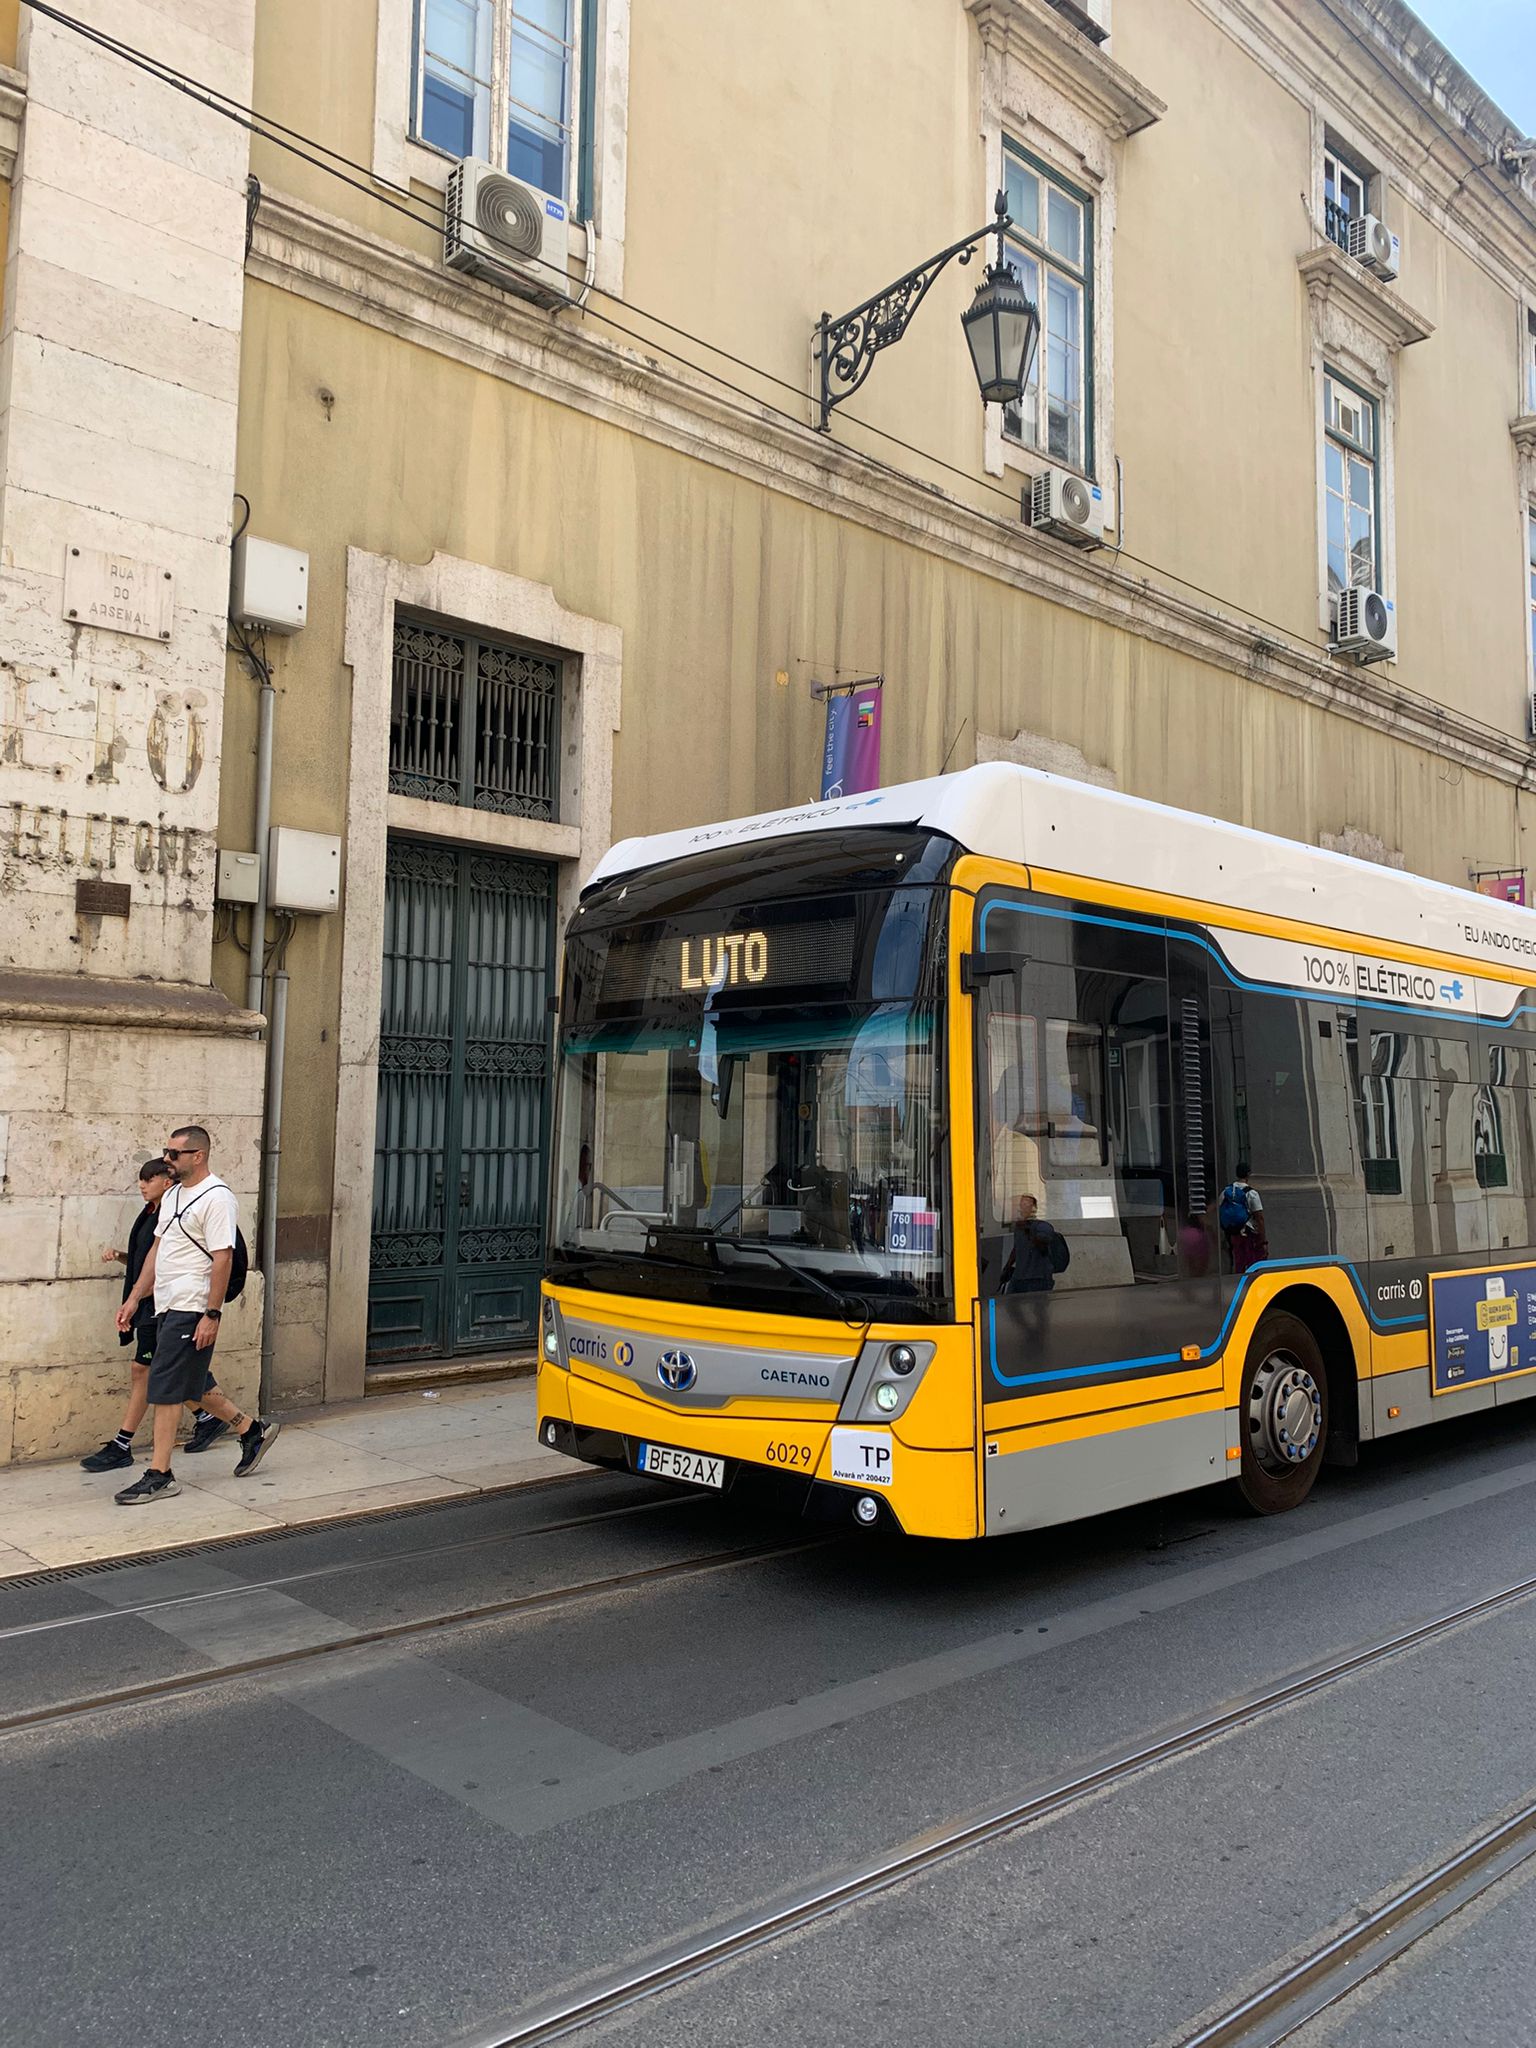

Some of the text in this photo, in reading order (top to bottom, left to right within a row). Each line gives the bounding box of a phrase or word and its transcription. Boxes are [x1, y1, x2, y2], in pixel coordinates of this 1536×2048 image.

[110, 564, 134, 581] RUA
[113, 586, 130, 600] DO
[89, 601, 150, 627] ARSENAL
[827, 733, 835, 753] the
[1464, 926, 1480, 943] EU
[1481, 930, 1511, 950] ANDO
[681, 932, 767, 988] LUTO
[1303, 955, 1436, 1001] 100% ELÉTRICO
[893, 1213, 910, 1225] 760
[892, 1234, 907, 1248] 09
[1377, 1279, 1406, 1301] carris
[569, 1335, 607, 1359] carris
[760, 1368, 830, 1387] CAETANO
[766, 1440, 812, 1467] 6029
[859, 1445, 891, 1468] TP
[866, 1473, 891, 1483] 200427
